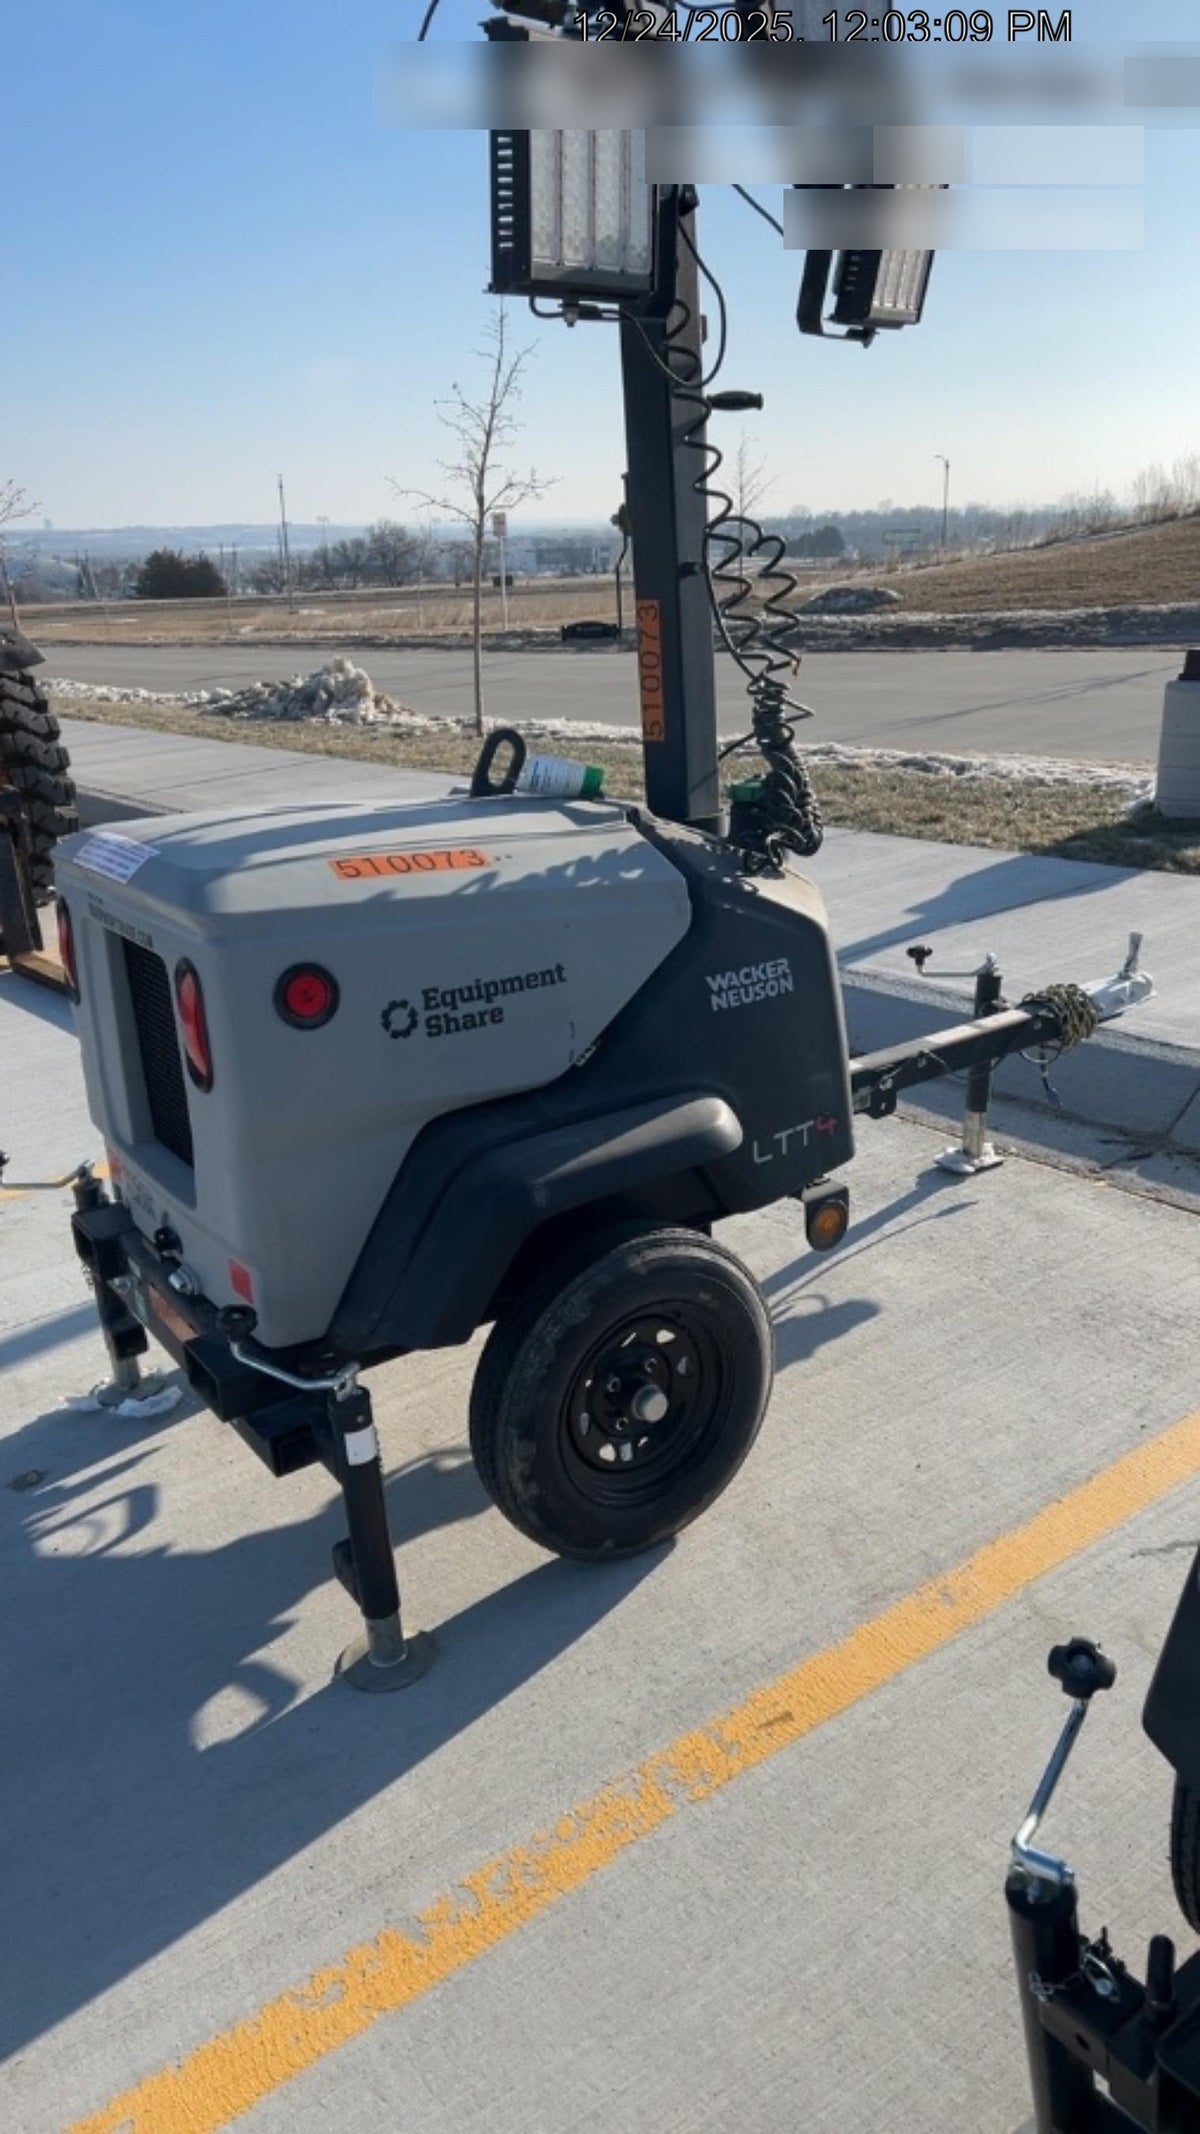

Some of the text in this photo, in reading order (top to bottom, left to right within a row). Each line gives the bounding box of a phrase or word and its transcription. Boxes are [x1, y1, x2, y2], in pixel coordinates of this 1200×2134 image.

[637, 603, 663, 738] 510073
[335, 850, 485, 878] 510073
[421, 963, 567, 1011] Equipment
[705, 957, 790, 992] WACKER
[710, 973, 794, 1011] NEUSON
[424, 1007, 504, 1037] Share
[753, 1118, 837, 1163] LTT4
